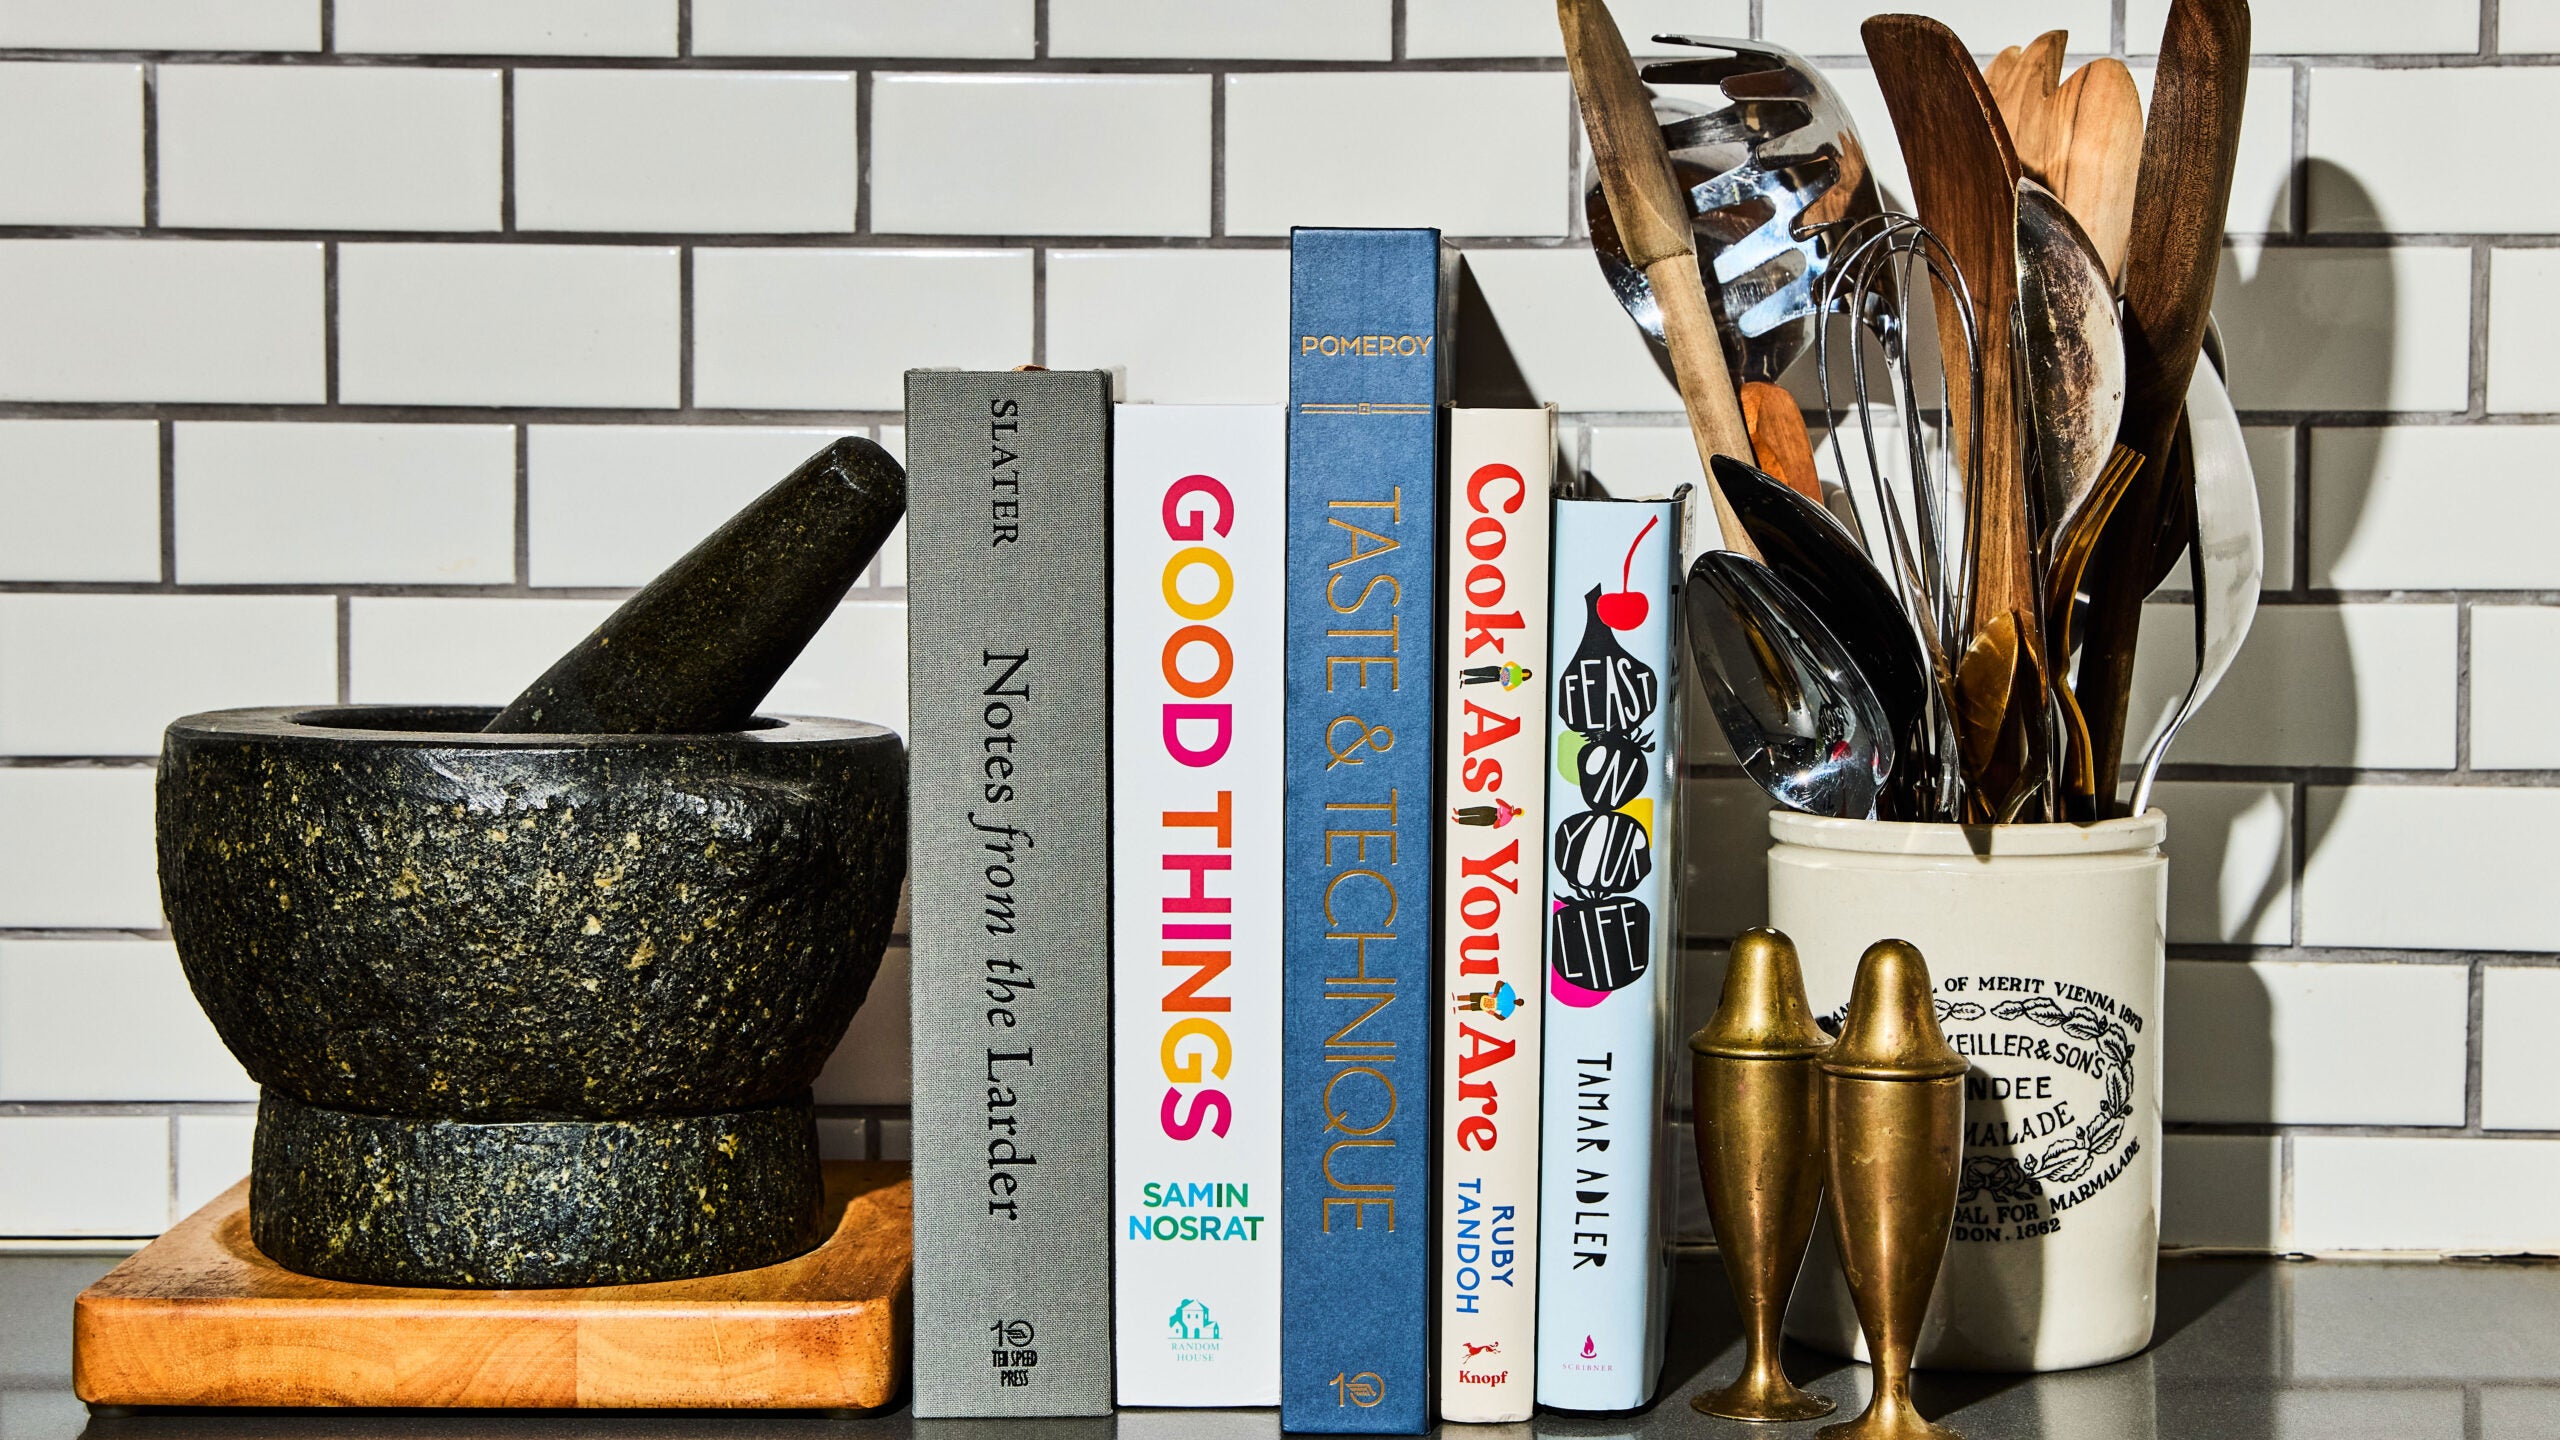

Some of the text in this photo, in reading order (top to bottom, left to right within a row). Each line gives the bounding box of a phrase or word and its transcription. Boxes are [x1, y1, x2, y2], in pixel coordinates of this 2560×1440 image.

[1301, 335, 1433, 357] POMEROY
[990, 398, 1019, 548] SLATER
[1565, 655, 1652, 732] FEAST
[1160, 474, 1234, 1141] GOOD THINGS
[1457, 463, 1526, 1152] Cook As You Are
[1585, 745, 1638, 806] ON
[1322, 485, 1401, 1234] TASTE & TECHNIQUE
[1563, 814, 1646, 888] YOUR
[968, 649, 1038, 1222] Notes from the Larder
[1557, 902, 1645, 989] LIFE
[1945, 976, 1969, 992] OF
[1978, 976, 2045, 994] MERIT
[2054, 981, 2115, 1015] VIENNA
[1573, 1052, 1612, 1270] TAMAR ADLER
[1996, 1203, 2040, 1224] FOR
[2049, 1136, 2141, 1215] MARMALADE
[1129, 1215, 1264, 1241] NOSRAT
[1143, 1182, 1249, 1208] SAMIN
[1456, 1177, 1481, 1314] TANDOH
[1491, 1205, 1515, 1287] RUBY
[2016, 1217, 2062, 1241] 1862
[991, 1350, 1037, 1367] TEN SPEED
[1000, 1370, 1029, 1387] PRESS
[1171, 1343, 1220, 1351] RANDOM
[1177, 1353, 1215, 1362] HOUSE
[1459, 1370, 1508, 1388] Knopf
[1562, 1363, 1613, 1372] SCRIBNER
